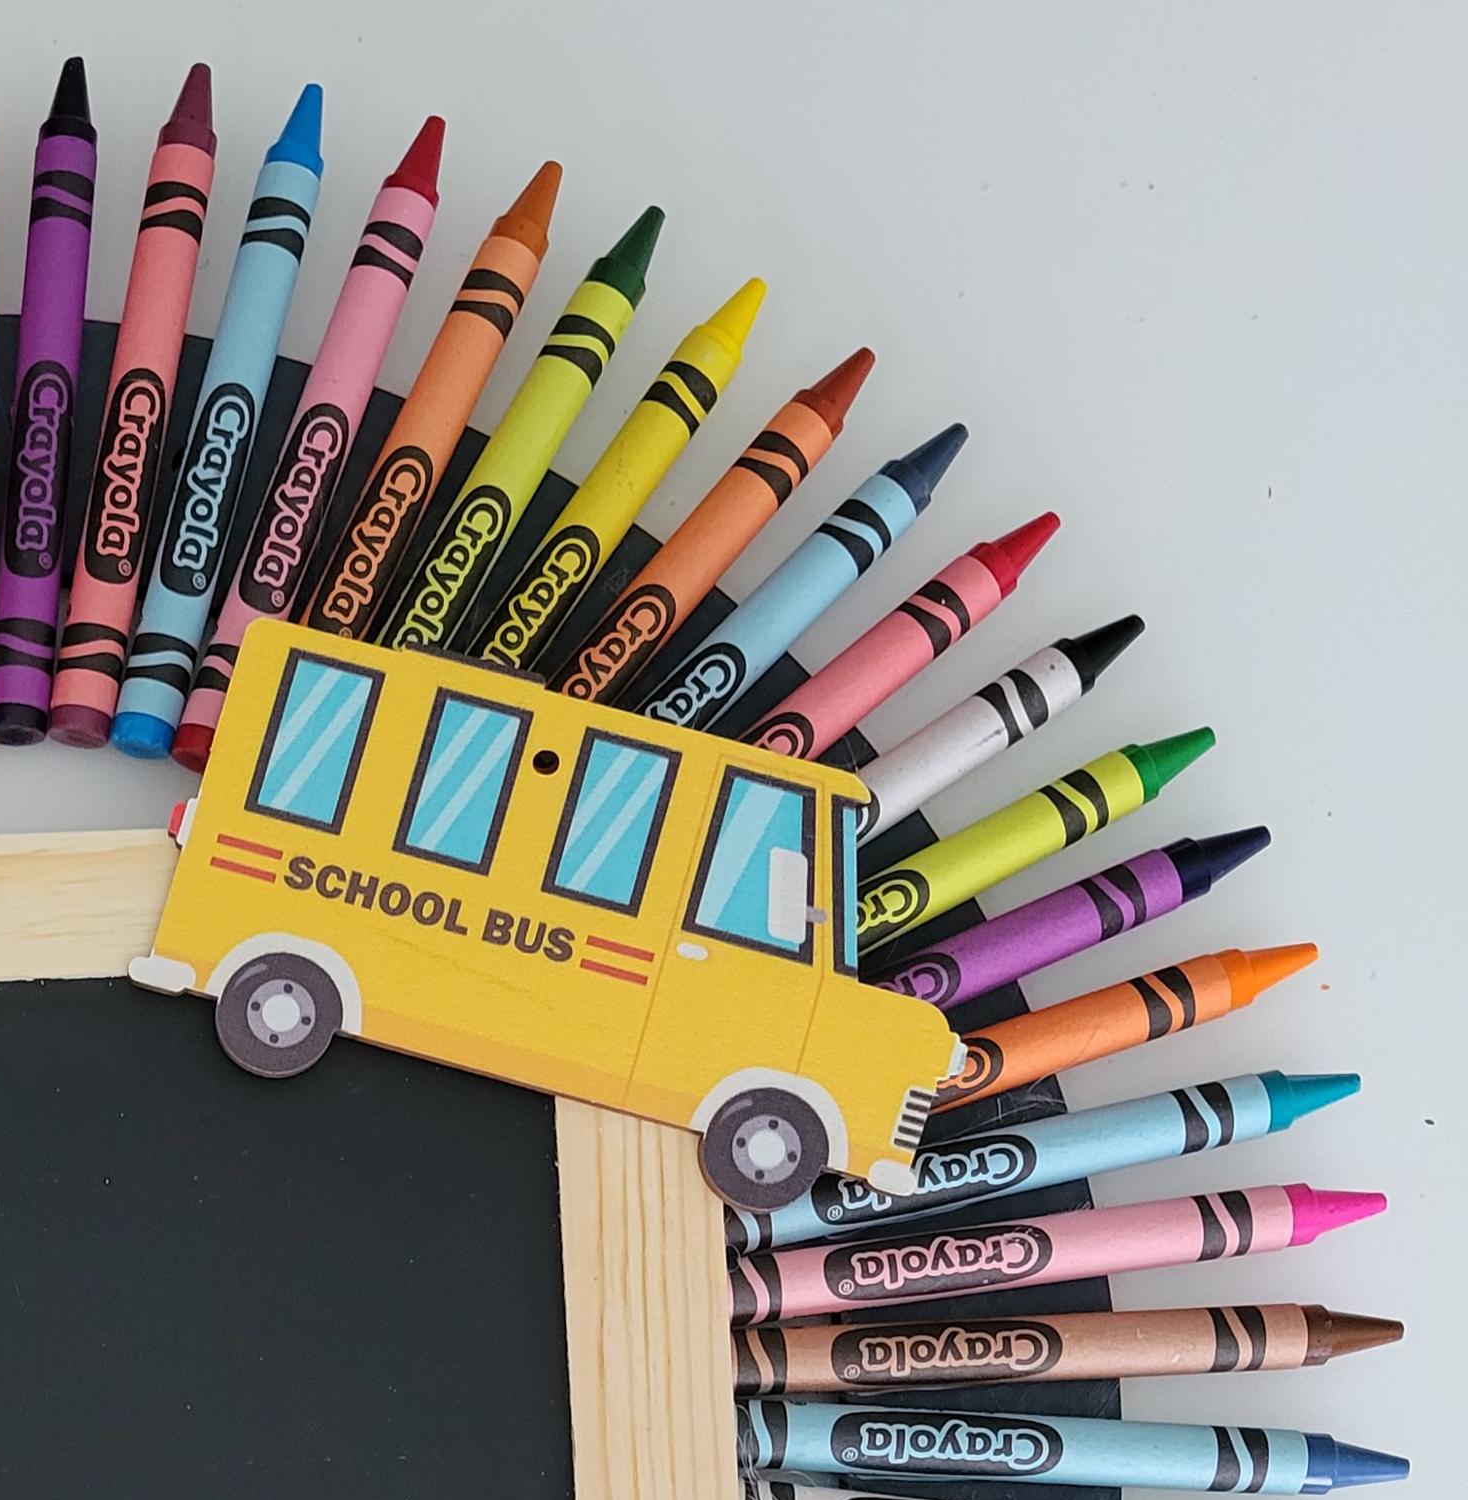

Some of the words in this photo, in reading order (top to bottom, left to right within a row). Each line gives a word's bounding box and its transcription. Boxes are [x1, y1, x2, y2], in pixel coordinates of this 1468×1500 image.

[16, 373, 68, 553] Crayola
[96, 379, 159, 558] Crayola
[172, 395, 250, 574] Crayola
[253, 416, 342, 600] Crayola
[323, 458, 426, 625] Crayola
[482, 537, 592, 670] Crayol
[562, 594, 667, 701] Crayo
[283, 855, 469, 936] SCHOOL
[484, 909, 576, 963] BUS
[853, 1231, 1040, 1288] Crayola
[860, 1326, 1050, 1378] Crayola
[861, 1419, 1051, 1470] Crayola
